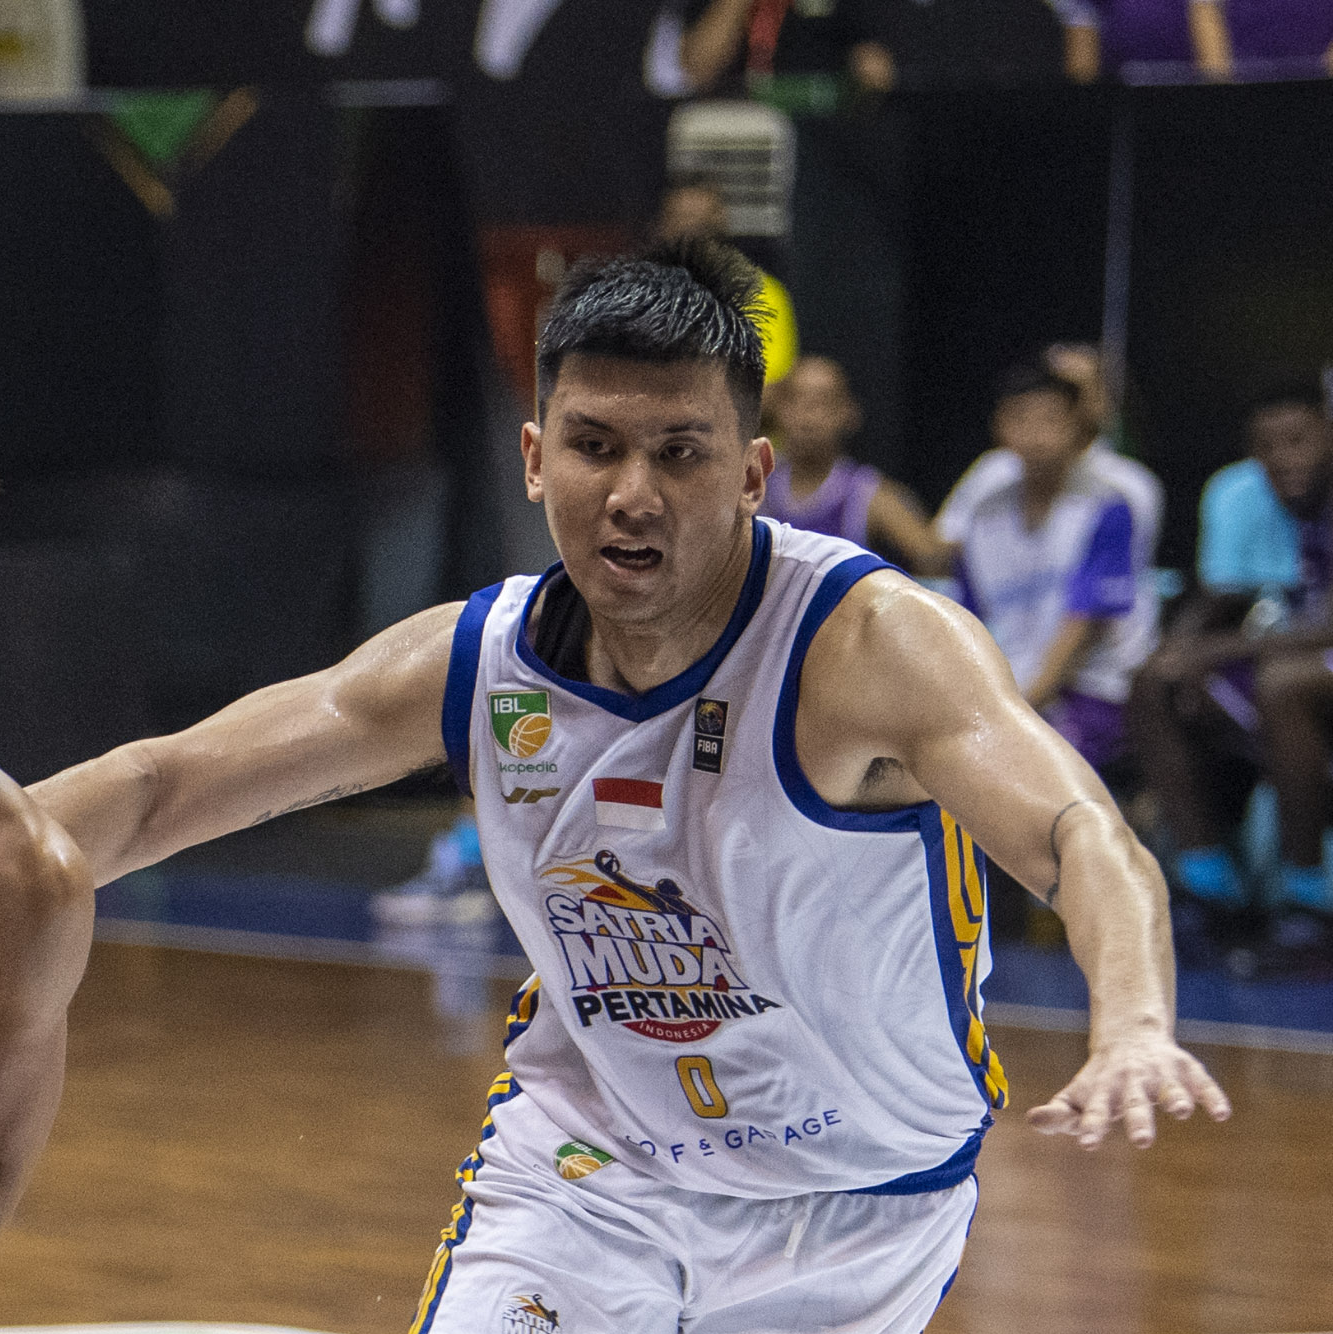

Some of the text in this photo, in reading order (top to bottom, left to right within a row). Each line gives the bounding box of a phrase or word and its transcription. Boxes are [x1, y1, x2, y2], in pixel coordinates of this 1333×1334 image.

[494, 697, 527, 714] IBL
[697, 739, 718, 755] FIBA
[499, 761, 558, 775] kopedia
[546, 893, 732, 954] SATRIA
[554, 930, 750, 990] MUDA
[571, 989, 783, 1028] PERTAMINA
[638, 1022, 711, 1040] INDONESIA
[675, 1055, 728, 1119] 0
